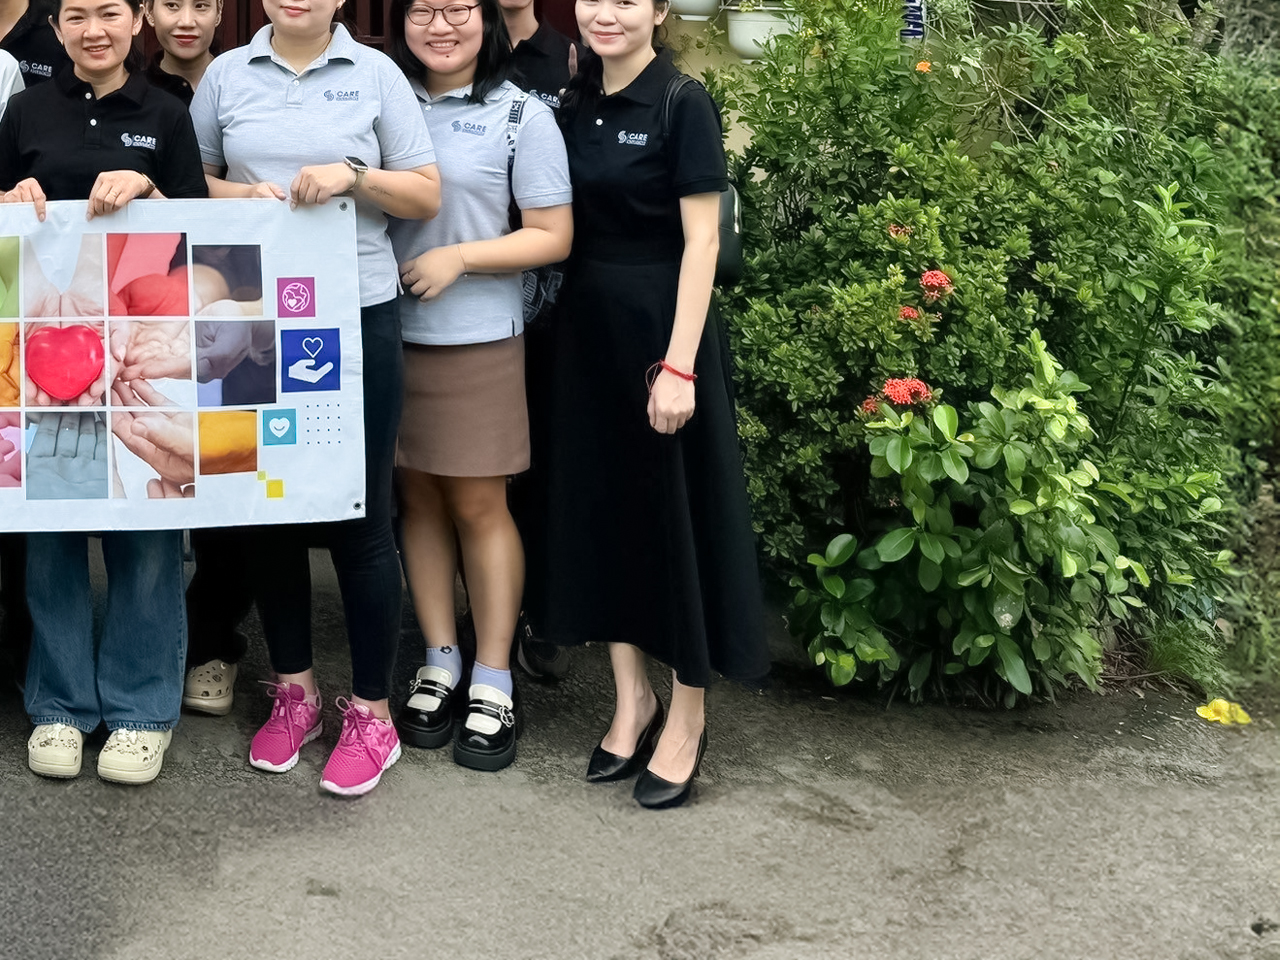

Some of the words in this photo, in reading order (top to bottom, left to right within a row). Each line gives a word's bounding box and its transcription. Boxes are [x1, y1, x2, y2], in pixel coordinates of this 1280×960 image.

[31, 62, 53, 73] CARE
[336, 90, 360, 98] CARE
[541, 93, 560, 104] CAR
[463, 122, 487, 132] CARE
[134, 134, 157, 145] CARE
[629, 132, 648, 141] CARE
